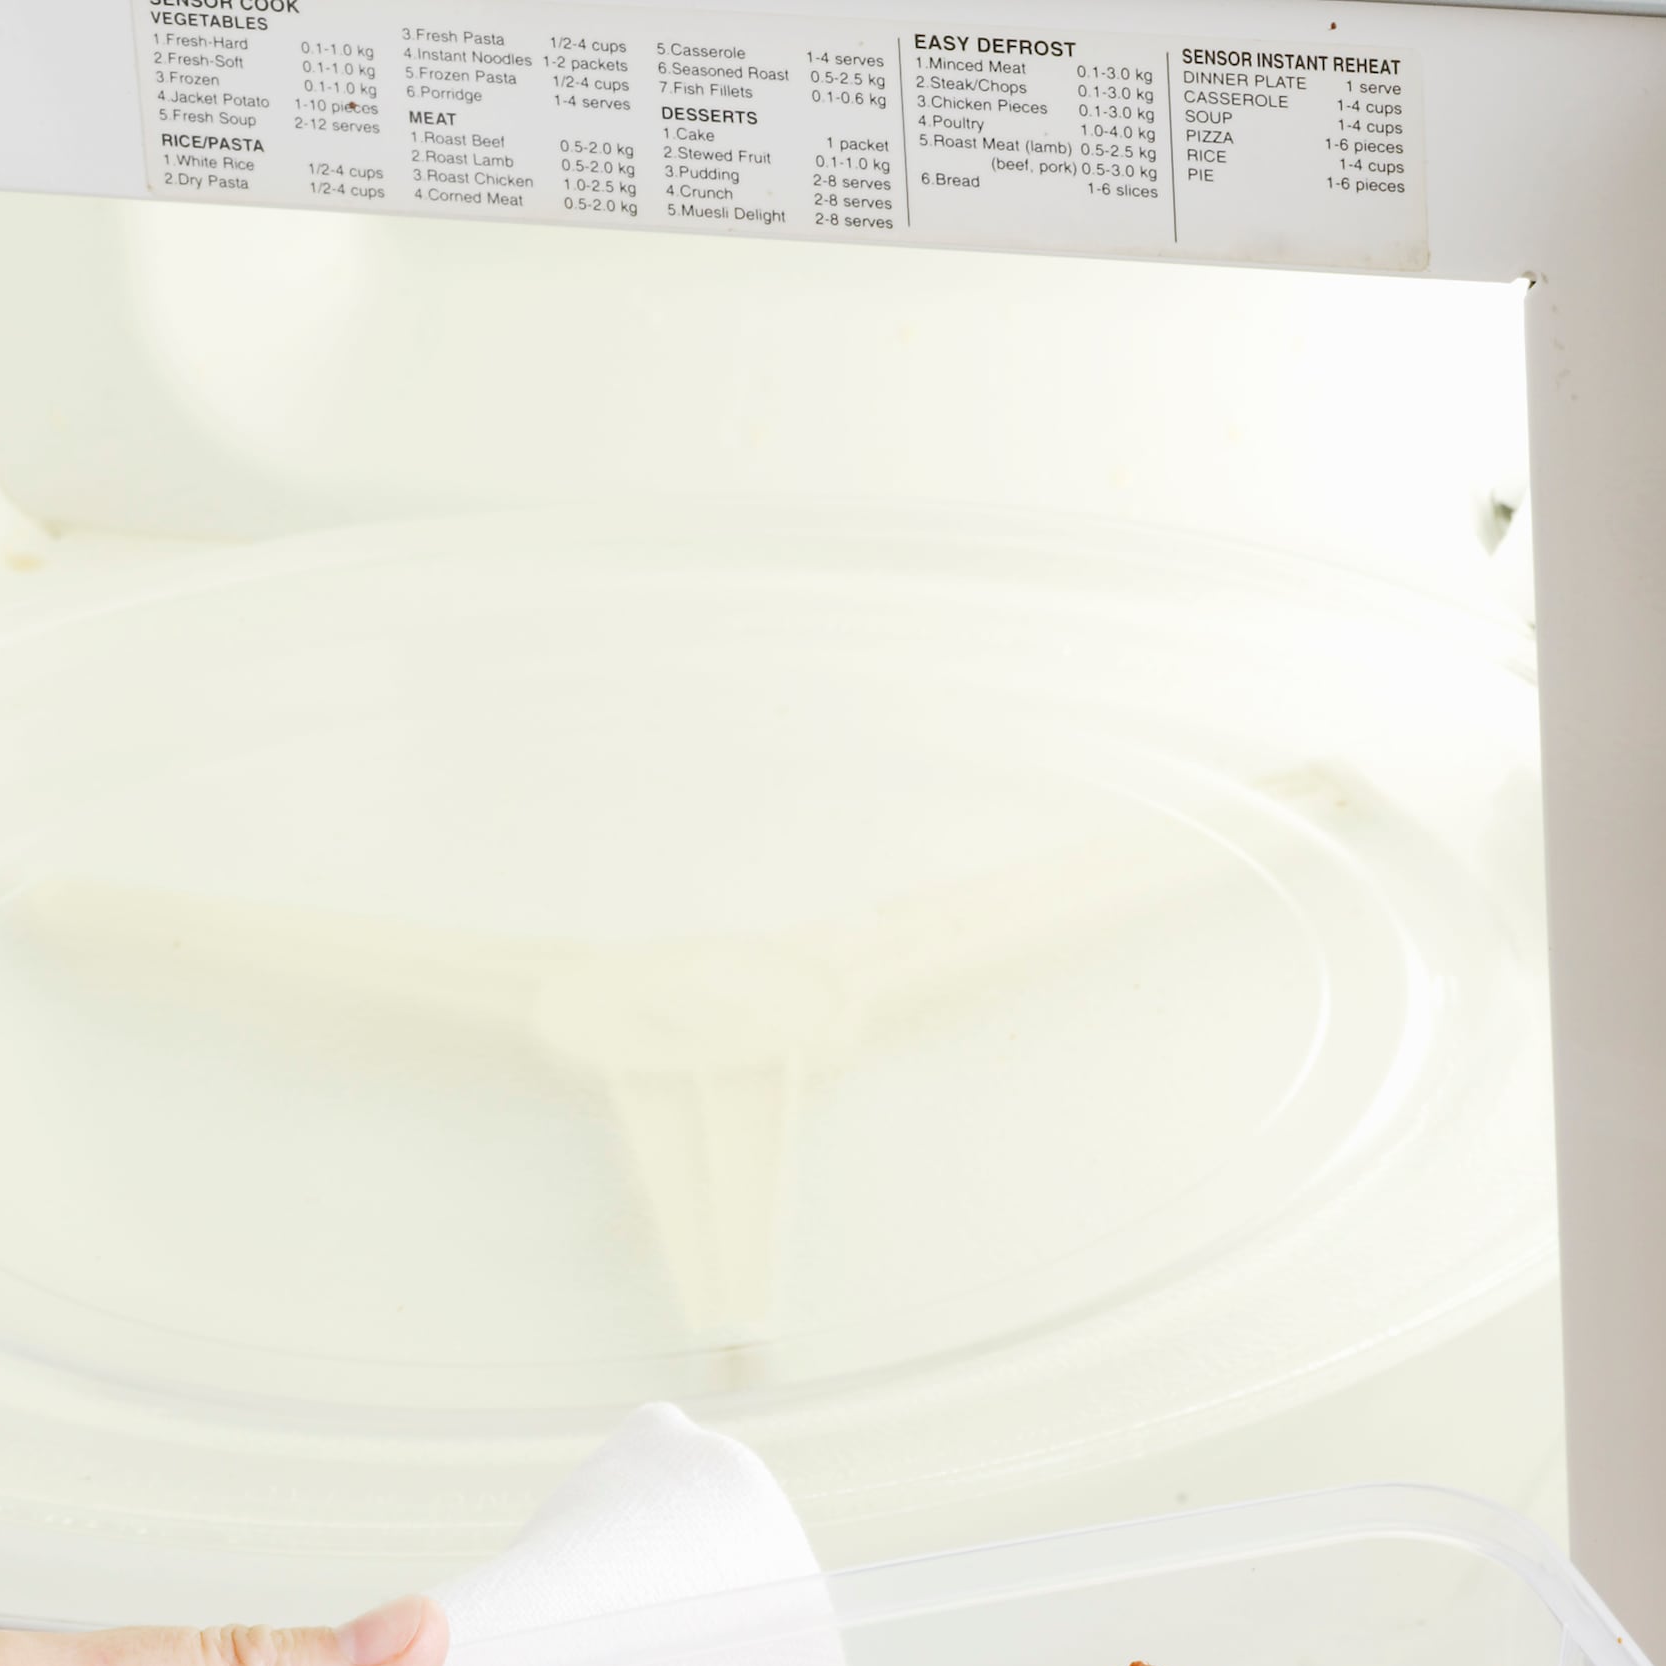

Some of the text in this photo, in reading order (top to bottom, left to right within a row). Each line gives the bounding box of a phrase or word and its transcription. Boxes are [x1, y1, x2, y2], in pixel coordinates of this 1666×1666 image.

[240, 0, 299, 13] COOK
[151, 11, 268, 31] VEGETABLES
[463, 31, 504, 46] Pasta
[551, 37, 627, 54] 1/2-4 cups
[915, 34, 1076, 57] EASY DEFROST
[472, 51, 532, 66] Noodles
[543, 56, 628, 72] 1-2 packets
[807, 51, 884, 67] 1-4 serves
[1182, 48, 1401, 75] SENSOR INSTANT REHEAT
[748, 66, 789, 81] Roast
[989, 60, 1025, 74] Meat
[475, 70, 517, 85] Pasta
[553, 75, 629, 93] 1/2-4 cups
[1184, 70, 1306, 90] DINNER PLATE
[710, 83, 753, 99] Fillets
[1347, 80, 1401, 95] 1 serve
[223, 93, 269, 108] Potato
[295, 98, 326, 112] 1-10
[555, 95, 631, 111] 1-4 serves
[998, 99, 1048, 115] Pieces
[1184, 90, 1288, 108] CASSEROLE
[662, 106, 758, 125] DESSERTS
[1338, 99, 1402, 117] 1-4 cups
[219, 112, 256, 128] Soup
[409, 111, 456, 125] MEAT
[1185, 109, 1232, 124] SOUP
[294, 116, 380, 134] 2-12 serves
[1339, 119, 1403, 136] 1-4 cups
[162, 133, 264, 152] RICE/PASTA
[472, 134, 504, 148] Beef
[827, 137, 888, 152] 1 packet
[1186, 129, 1234, 144] PIZZA
[983, 137, 1019, 151] Meat
[1025, 140, 1072, 157] (lamb)
[1326, 138, 1404, 154] 1-6 pieces
[473, 153, 514, 168] Lamb
[738, 150, 771, 164] Fruit
[1187, 148, 1226, 163] RICE
[223, 157, 254, 171] Rice
[309, 163, 383, 181] 1/2-4 cups
[1039, 161, 1077, 176] pork)
[1340, 158, 1404, 176] 1-4 cups
[208, 174, 249, 189] Pasta
[474, 172, 533, 187] Chicken
[813, 174, 891, 191] 2-8 serves
[1188, 168, 1213, 182] PIE
[311, 182, 385, 200] 1/2-4 cups
[1088, 182, 1158, 198] 1-6 slices
[1327, 177, 1405, 193] 1-6 pieces
[487, 192, 523, 206] Meat
[814, 193, 892, 210] 2-8 serves
[734, 207, 785, 225] Delight
[815, 212, 893, 229] 2-8 serves
